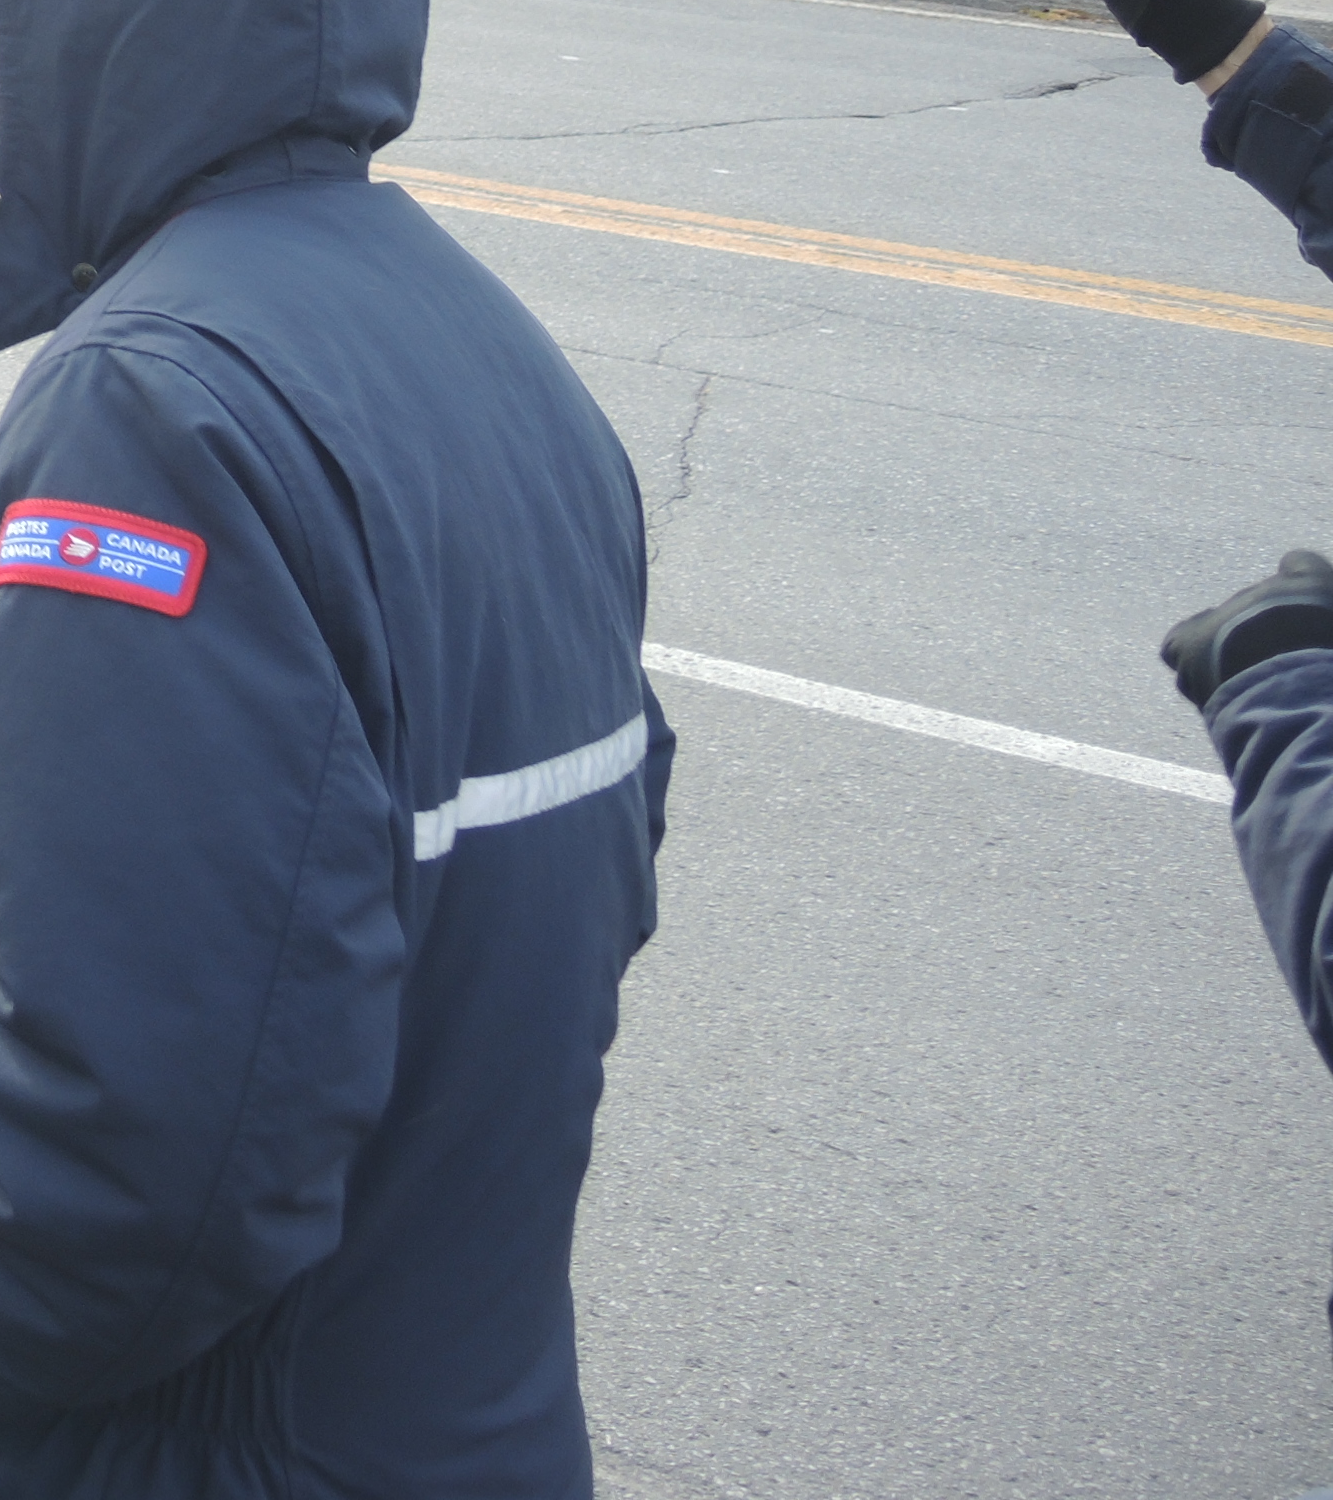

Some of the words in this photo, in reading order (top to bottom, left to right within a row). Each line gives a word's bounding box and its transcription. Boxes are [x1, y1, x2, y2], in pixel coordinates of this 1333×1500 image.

[6, 520, 50, 537] POSTES
[0, 544, 52, 560] CANADA
[105, 532, 183, 567] CANADA
[98, 555, 148, 580] POST
